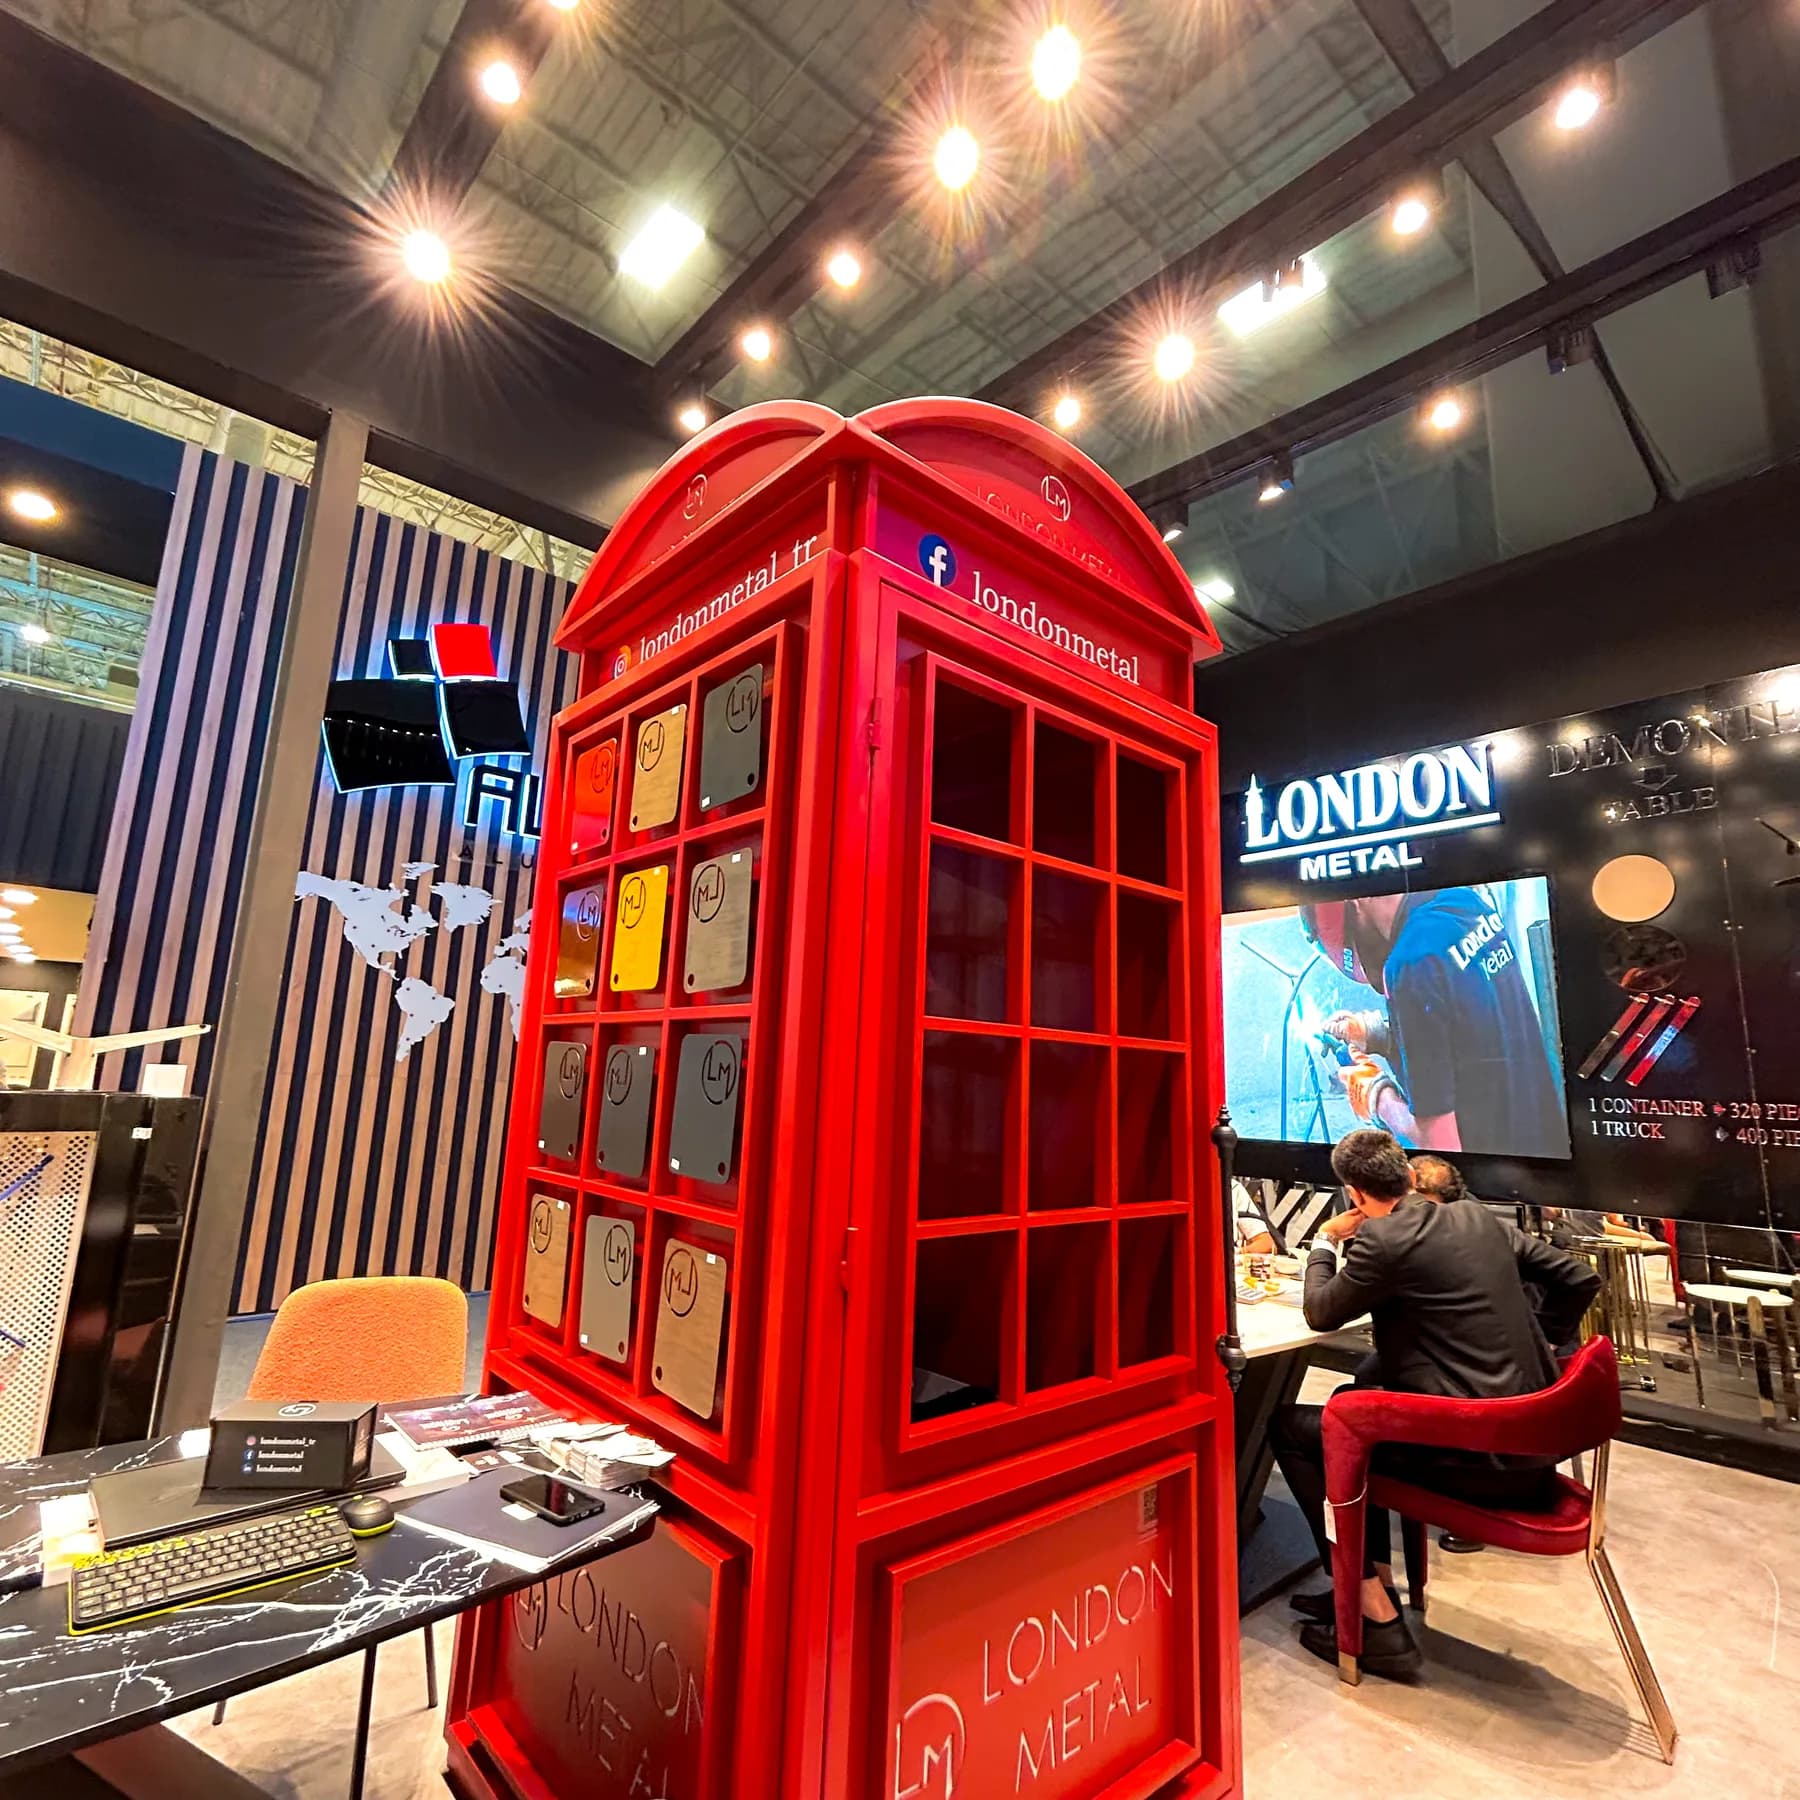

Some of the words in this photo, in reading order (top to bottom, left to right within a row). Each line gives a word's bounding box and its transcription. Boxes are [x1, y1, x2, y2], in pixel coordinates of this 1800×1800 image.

[972, 571, 1140, 686] londonmetal
[1244, 740, 1495, 848] LONDON
[1601, 787, 1719, 824] TABLE
[1300, 842, 1424, 881] METAL
[1480, 940, 1514, 980] etal
[1589, 1098, 1597, 1113] 1
[1602, 1098, 1707, 1117] CONTAINER
[1730, 1103, 1761, 1119] 320
[1765, 1103, 1800, 1121] PIE
[1592, 1120, 1599, 1136] 1
[1602, 1121, 1666, 1139] TRUCK
[1736, 1128, 1768, 1145] 400
[984, 1549, 1174, 1706] LONDON
[1015, 1656, 1152, 1794] METAL
